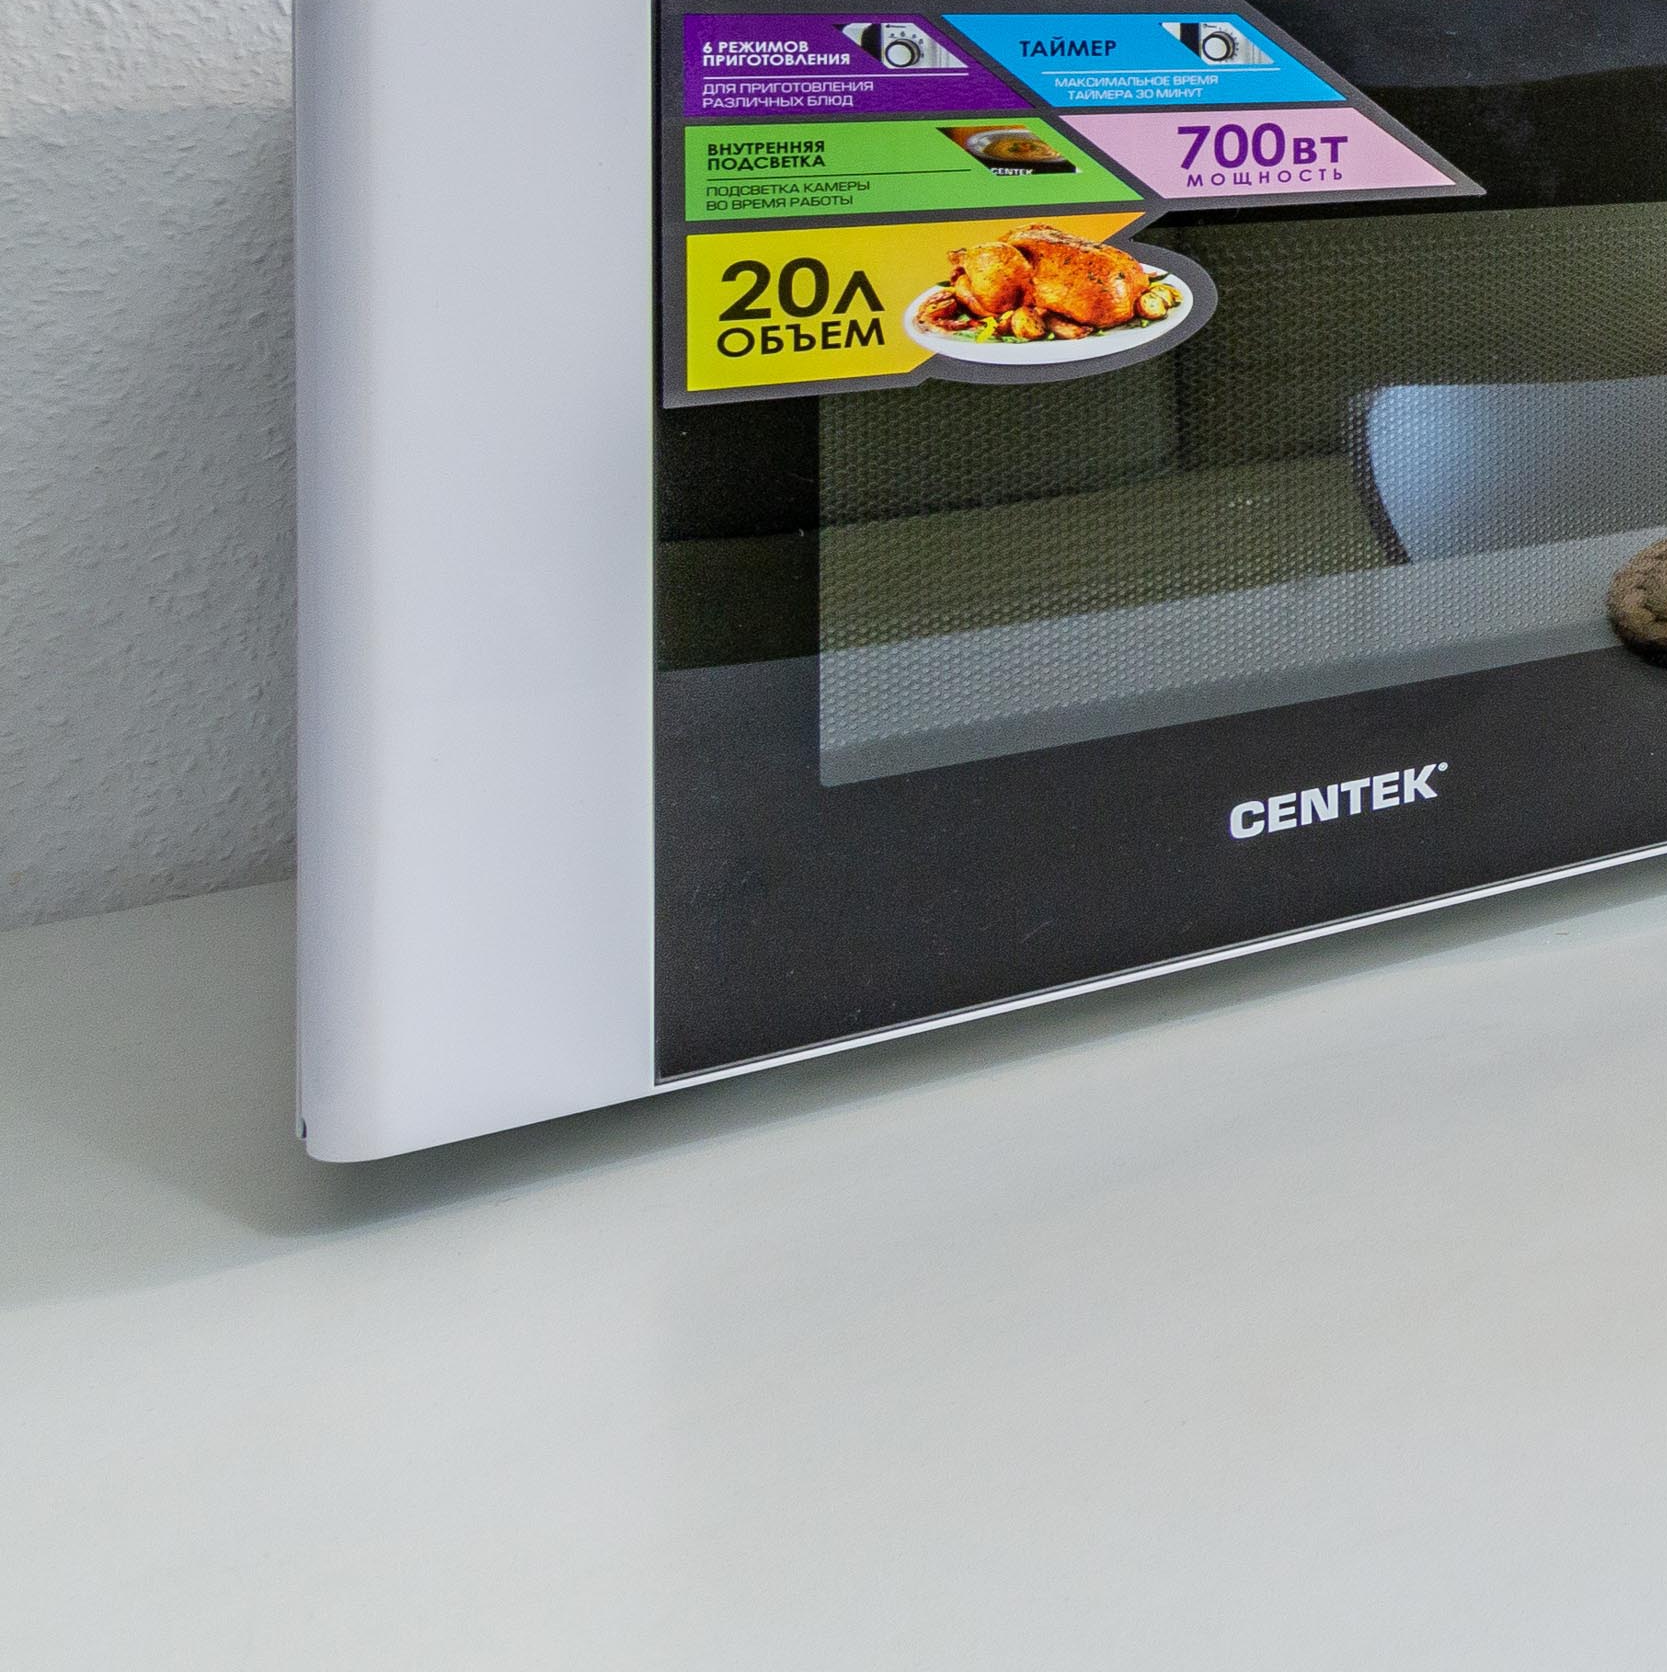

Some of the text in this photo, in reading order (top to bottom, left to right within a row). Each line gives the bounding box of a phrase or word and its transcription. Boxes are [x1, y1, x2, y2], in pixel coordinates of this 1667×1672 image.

[703, 40, 809, 54] 6 РЕЖИМОВ
[1019, 35, 1117, 57] ТАЙМЕР
[703, 53, 851, 67] ПРИГОТОВЛЕНИЯ
[702, 81, 874, 97] ДЛЯ ПРИГОТОВЛЕНИЯ
[1054, 75, 1219, 88] МАКСИМАЛЬНОЕ ВРЕМЯ
[702, 95, 854, 109] РАЗЛИЧНЫХ БЛЮД
[1067, 87, 1203, 101] ТАЙМЕРА 30 МИНУТ
[707, 140, 825, 156] ВНУТРЕННЯЯ
[707, 155, 826, 171] ПОДСВЕТКА
[1186, 167, 1344, 188] МОЩНОСТЬ
[706, 181, 870, 198] ПОДСВЕТКА КАМЕРЫ
[706, 195, 853, 211] ВО ВРЕМЯ РАБОТЫ
[716, 319, 885, 359] ОБЪЕМ
